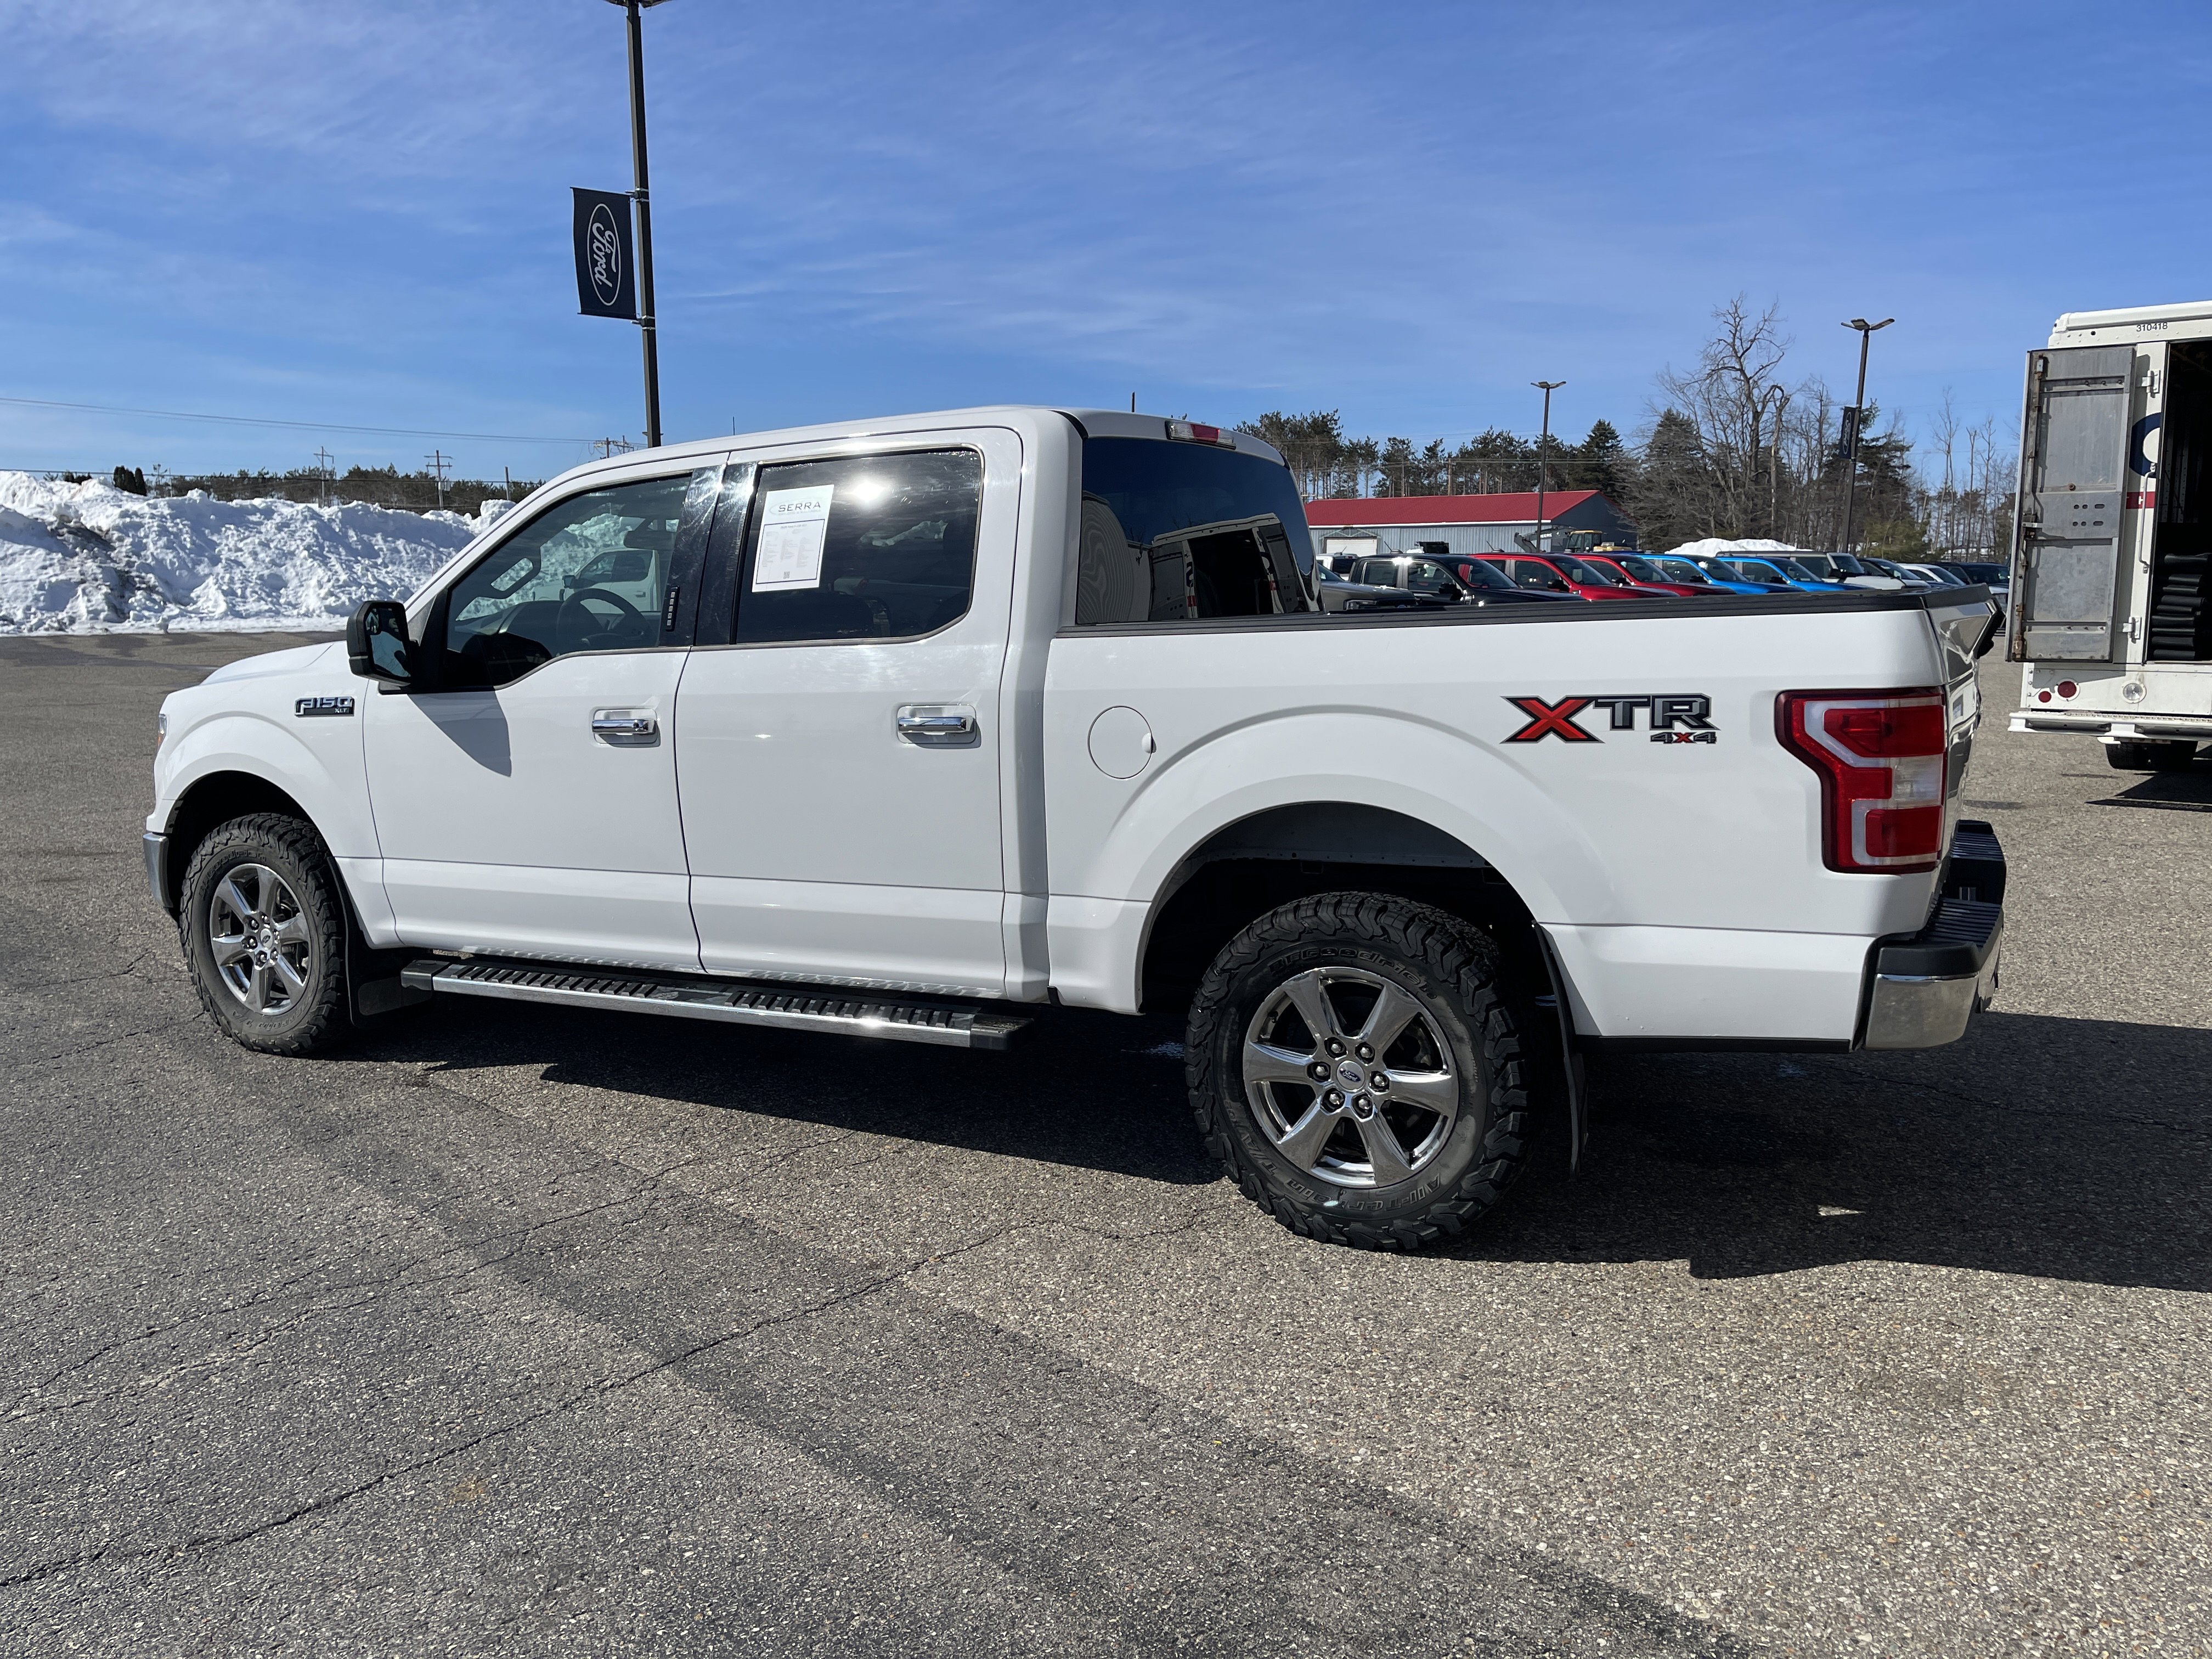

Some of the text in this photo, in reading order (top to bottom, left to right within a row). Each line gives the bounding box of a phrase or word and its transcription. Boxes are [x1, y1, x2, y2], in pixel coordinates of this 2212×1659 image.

[592, 222, 616, 287] Ford
[2136, 321, 2168, 332] 310418
[778, 501, 821, 512] SERRA
[1499, 693, 1721, 744] XTR
